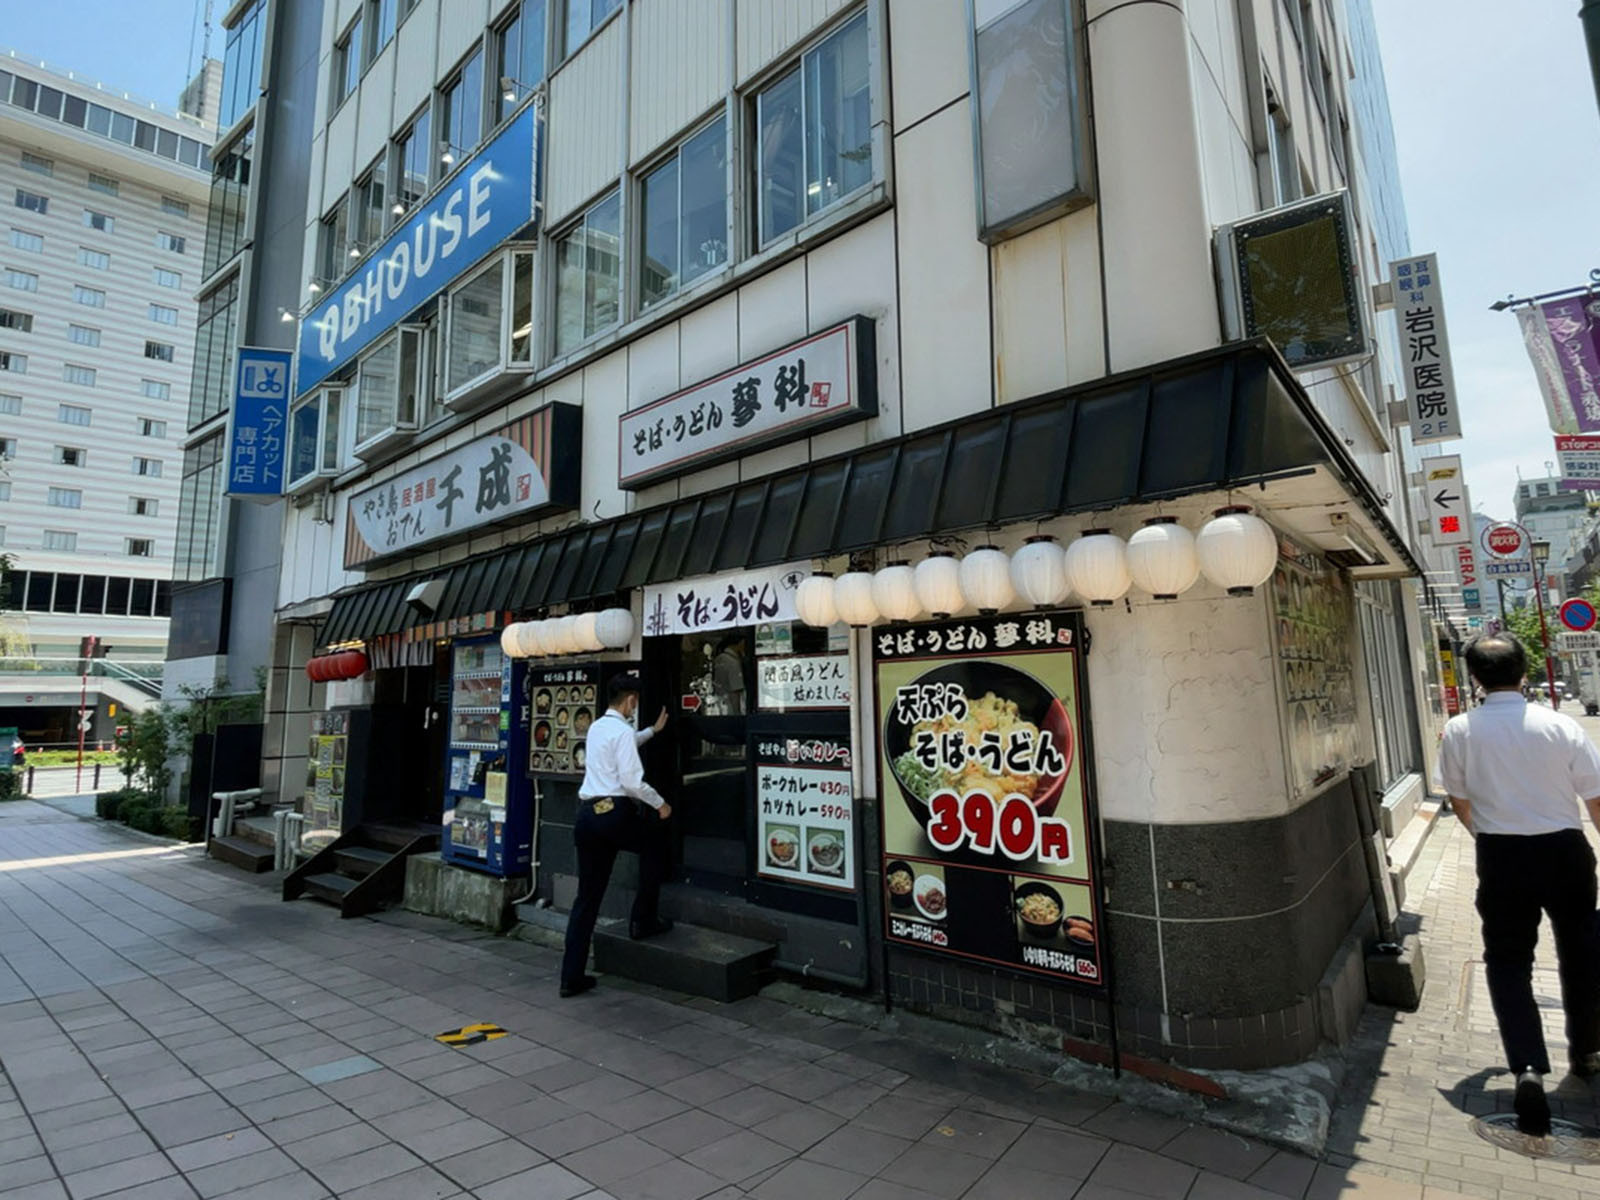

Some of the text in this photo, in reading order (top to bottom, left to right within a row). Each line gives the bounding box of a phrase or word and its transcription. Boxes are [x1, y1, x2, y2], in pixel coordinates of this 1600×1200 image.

[1405, 306, 1448, 420] 岩沢医院
[260, 404, 283, 484] ヘアカット
[633, 401, 723, 456] そば・うどん
[1421, 421, 1449, 436] 2F
[233, 426, 258, 484] 専門店
[363, 483, 398, 522] やき鳥
[401, 477, 437, 508] 居酒屋
[436, 442, 513, 528] 千成
[386, 508, 426, 547] おでん
[677, 582, 779, 628] そば・うどん
[878, 625, 988, 655] そば・うどん
[993, 619, 1056, 648] 蓼科
[763, 662, 845, 684] 関西風うどん
[793, 685, 841, 702] 始めました
[897, 682, 969, 724] 天ぷら
[914, 730, 1067, 777] そば・うどん
[763, 797, 850, 820] カツカレー 590円
[927, 788, 1074, 866] 390円
